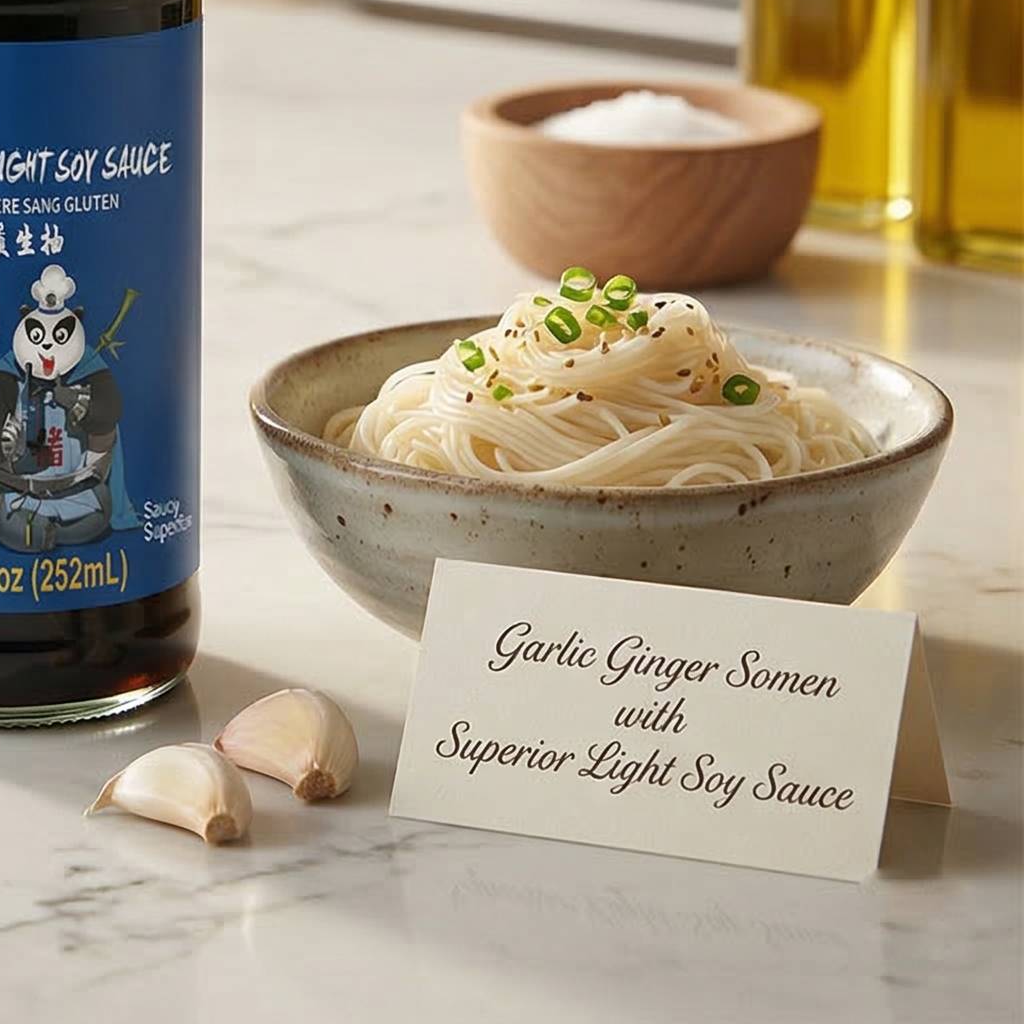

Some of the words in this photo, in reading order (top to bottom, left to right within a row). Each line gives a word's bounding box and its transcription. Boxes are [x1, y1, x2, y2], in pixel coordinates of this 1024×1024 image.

[54, 148, 98, 184] SOY
[101, 141, 172, 178] SAUCE
[23, 196, 60, 214] SANG
[64, 193, 120, 213] GLUTEN
[31, 548, 128, 602] (252mL)
[488, 621, 597, 672] Garlic
[600, 635, 719, 692] Ginger
[726, 649, 841, 699] Somen
[614, 697, 688, 734] with
[435, 720, 575, 774] Superior
[578, 740, 676, 795] Light
[680, 752, 745, 809] Soy
[752, 762, 855, 811] Sauce
